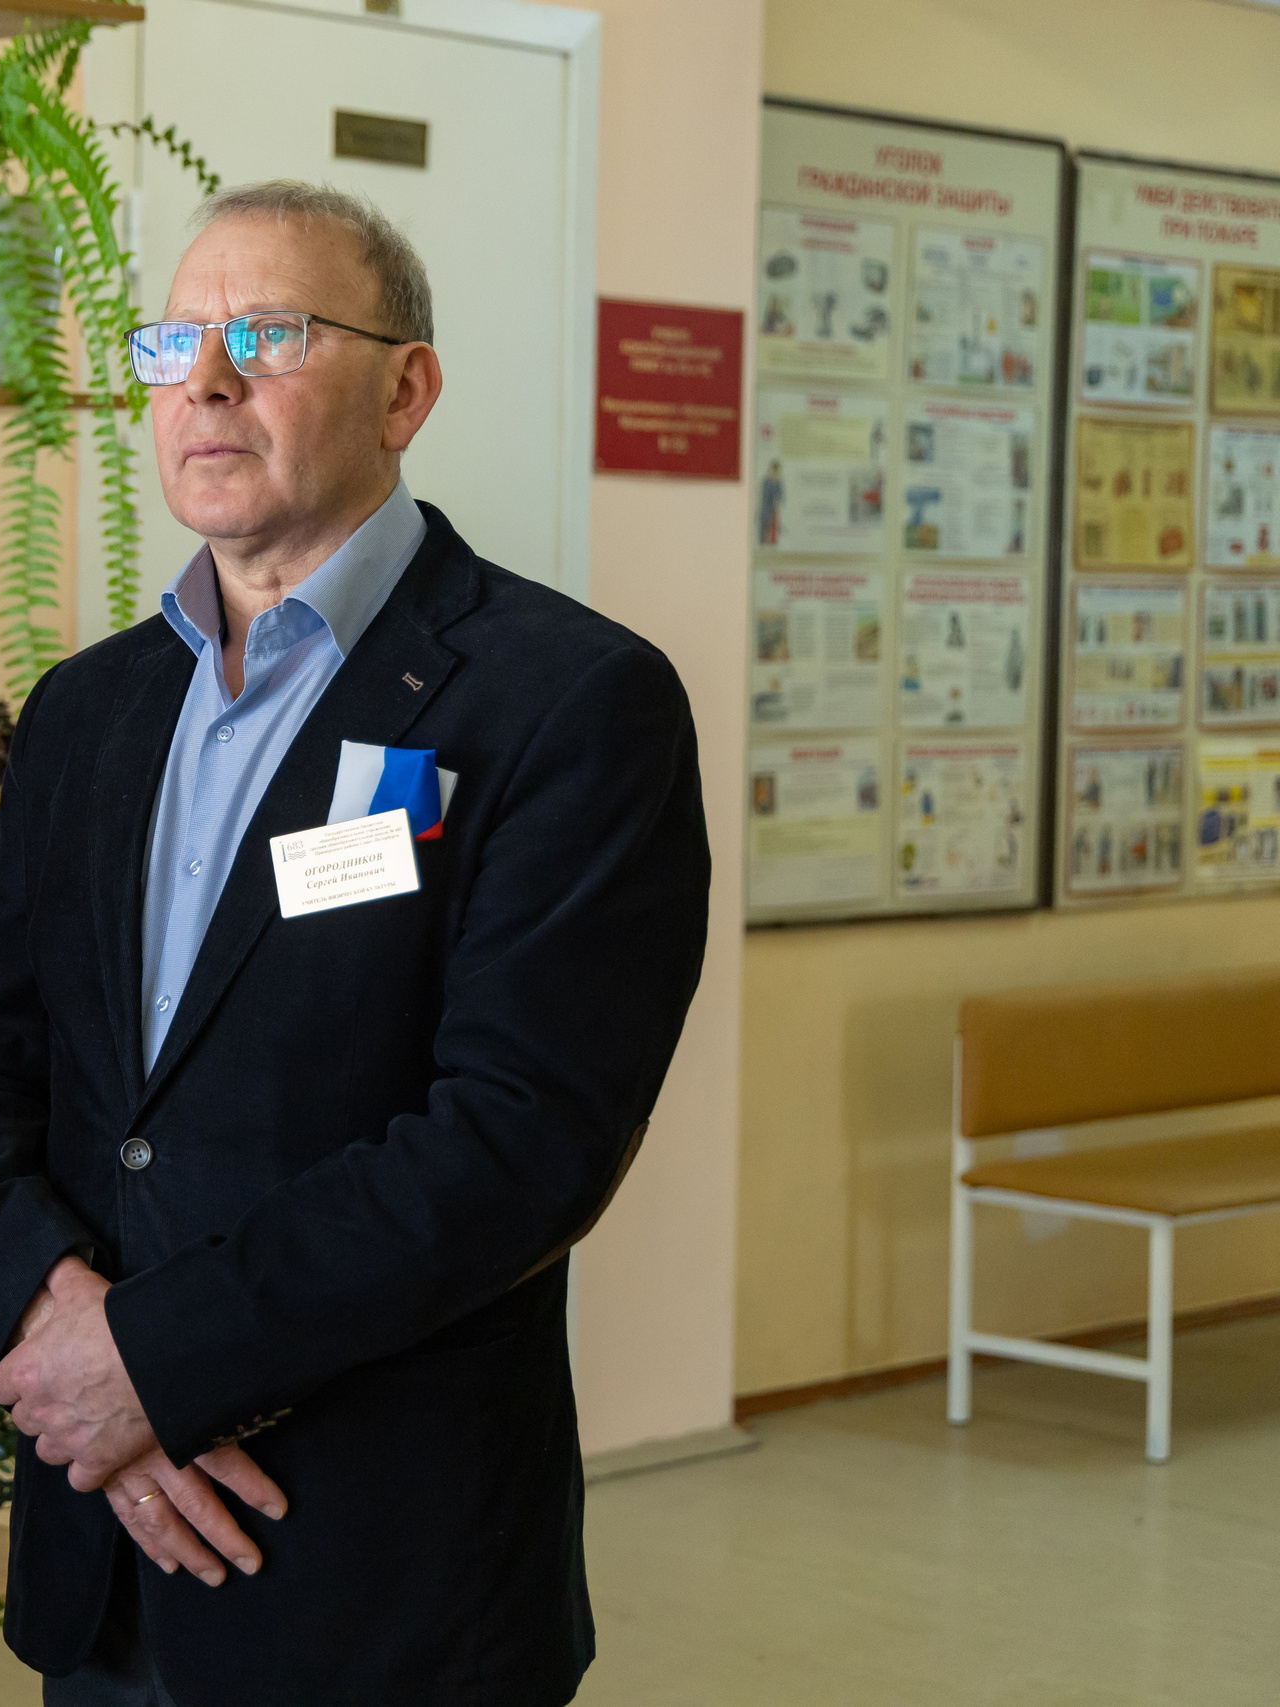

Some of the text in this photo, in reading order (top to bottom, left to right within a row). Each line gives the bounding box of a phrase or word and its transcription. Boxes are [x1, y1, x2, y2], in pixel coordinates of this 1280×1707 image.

[937, 183, 1013, 216] ЗАЩИТЫ
[287, 840, 304, 852] 683
[304, 852, 383, 877] ОГОРОДНИКОВ
[306, 867, 386, 890] Сергей Иванович
[301, 881, 396, 906] УЧИТЕЛЬ ФИЗИЧЕСКОЙ КУЛЬТУРЫ
